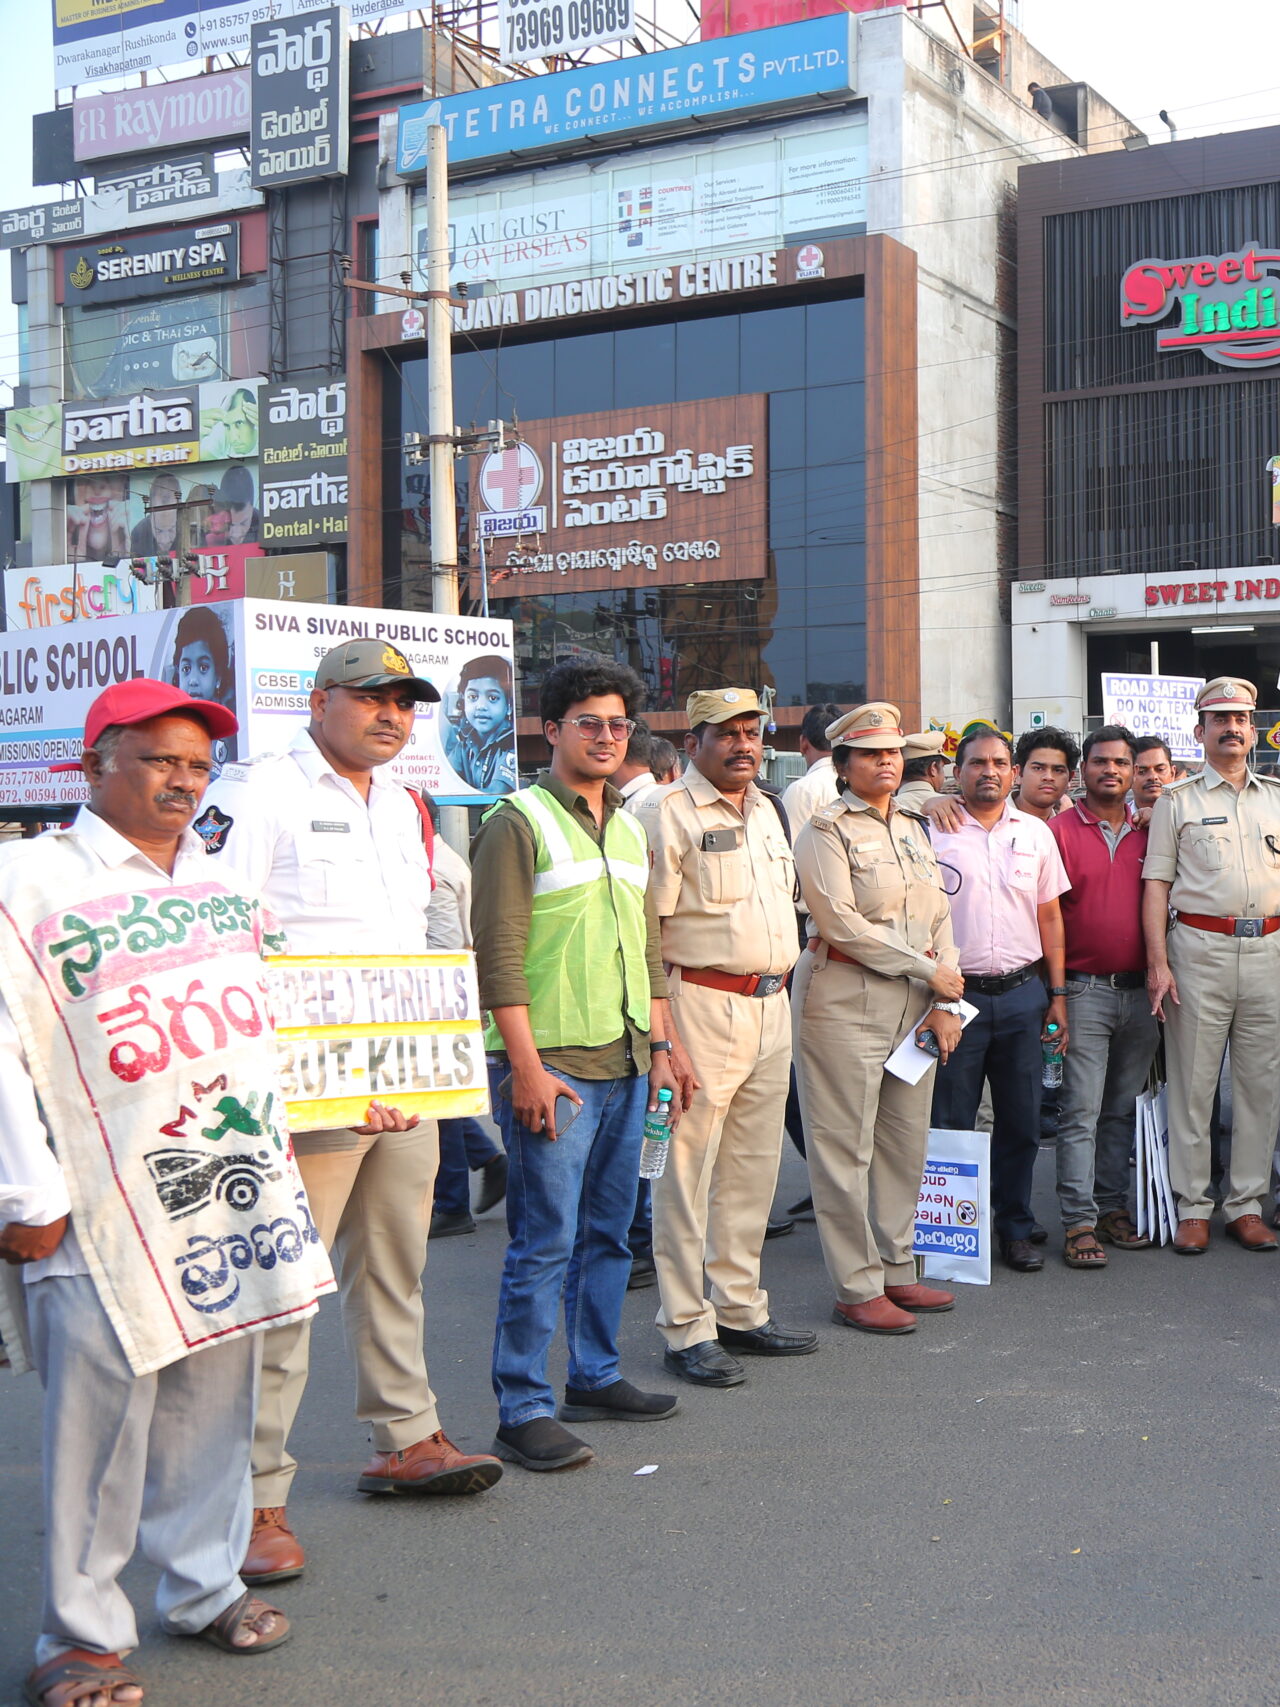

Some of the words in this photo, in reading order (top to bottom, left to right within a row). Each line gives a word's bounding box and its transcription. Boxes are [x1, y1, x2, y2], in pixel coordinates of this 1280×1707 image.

[506, 7, 564, 54] 73969
[568, 0, 631, 39] 09689
[57, 45, 121, 66] Dwarakanagar
[124, 30, 177, 51] Rushikonda
[84, 55, 152, 77] Visakhapatnam
[114, 74, 251, 145] Raymond
[445, 94, 548, 142] TETRA
[565, 52, 756, 117] CONNECTS
[763, 49, 845, 79] PVT.LTD.
[545, 124, 560, 134] WE
[638, 105, 653, 117] WE
[788, 166, 798, 174] For
[800, 163, 817, 171] more
[136, 178, 211, 209] partha
[97, 247, 187, 281] SERENITY
[188, 241, 227, 266] SPA
[172, 271, 201, 282] WELLNESS
[202, 267, 225, 277] CENTRE
[449, 293, 519, 333] IJAYA
[525, 268, 673, 322] DIAGNOSTIC
[679, 251, 777, 297] CENTRE
[1122, 249, 1263, 319] Sweet
[184, 324, 207, 337] SPA
[65, 395, 193, 451] partha
[65, 453, 135, 474] Dental
[146, 444, 192, 465] Hair
[563, 428, 665, 464] విజయ
[264, 472, 348, 517] partha
[563, 487, 667, 528] సెంటర్
[264, 519, 312, 539] Dental
[323, 516, 348, 533] Hai
[483, 514, 538, 532] విజయ
[19, 574, 137, 629] firstcry
[1145, 581, 1228, 607] SWEET
[255, 613, 301, 633] SIVA
[307, 617, 369, 639] SIVANI
[376, 623, 439, 643] PUBLIC
[444, 629, 511, 649] SCHOOL
[0, 647, 38, 695] LIC
[46, 635, 145, 692] SCHOOL
[258, 675, 298, 688] CBSE
[306, 681, 313, 689] &
[1111, 679, 1149, 696] ROAD
[1152, 681, 1201, 700] SAFETY
[1117, 699, 1134, 712] DO
[1139, 699, 1163, 713] NOT
[1167, 701, 1195, 715] TEXT
[1133, 715, 1150, 729] OR
[1154, 716, 1182, 730] CALL
[43, 739, 70, 761] OPEN
[399, 753, 435, 762] Contact:
[408, 765, 440, 775] 00972
[25, 788, 57, 802] 90594
[361, 967, 469, 1023] THRILLS
[918, 1192, 953, 1208] Neve
